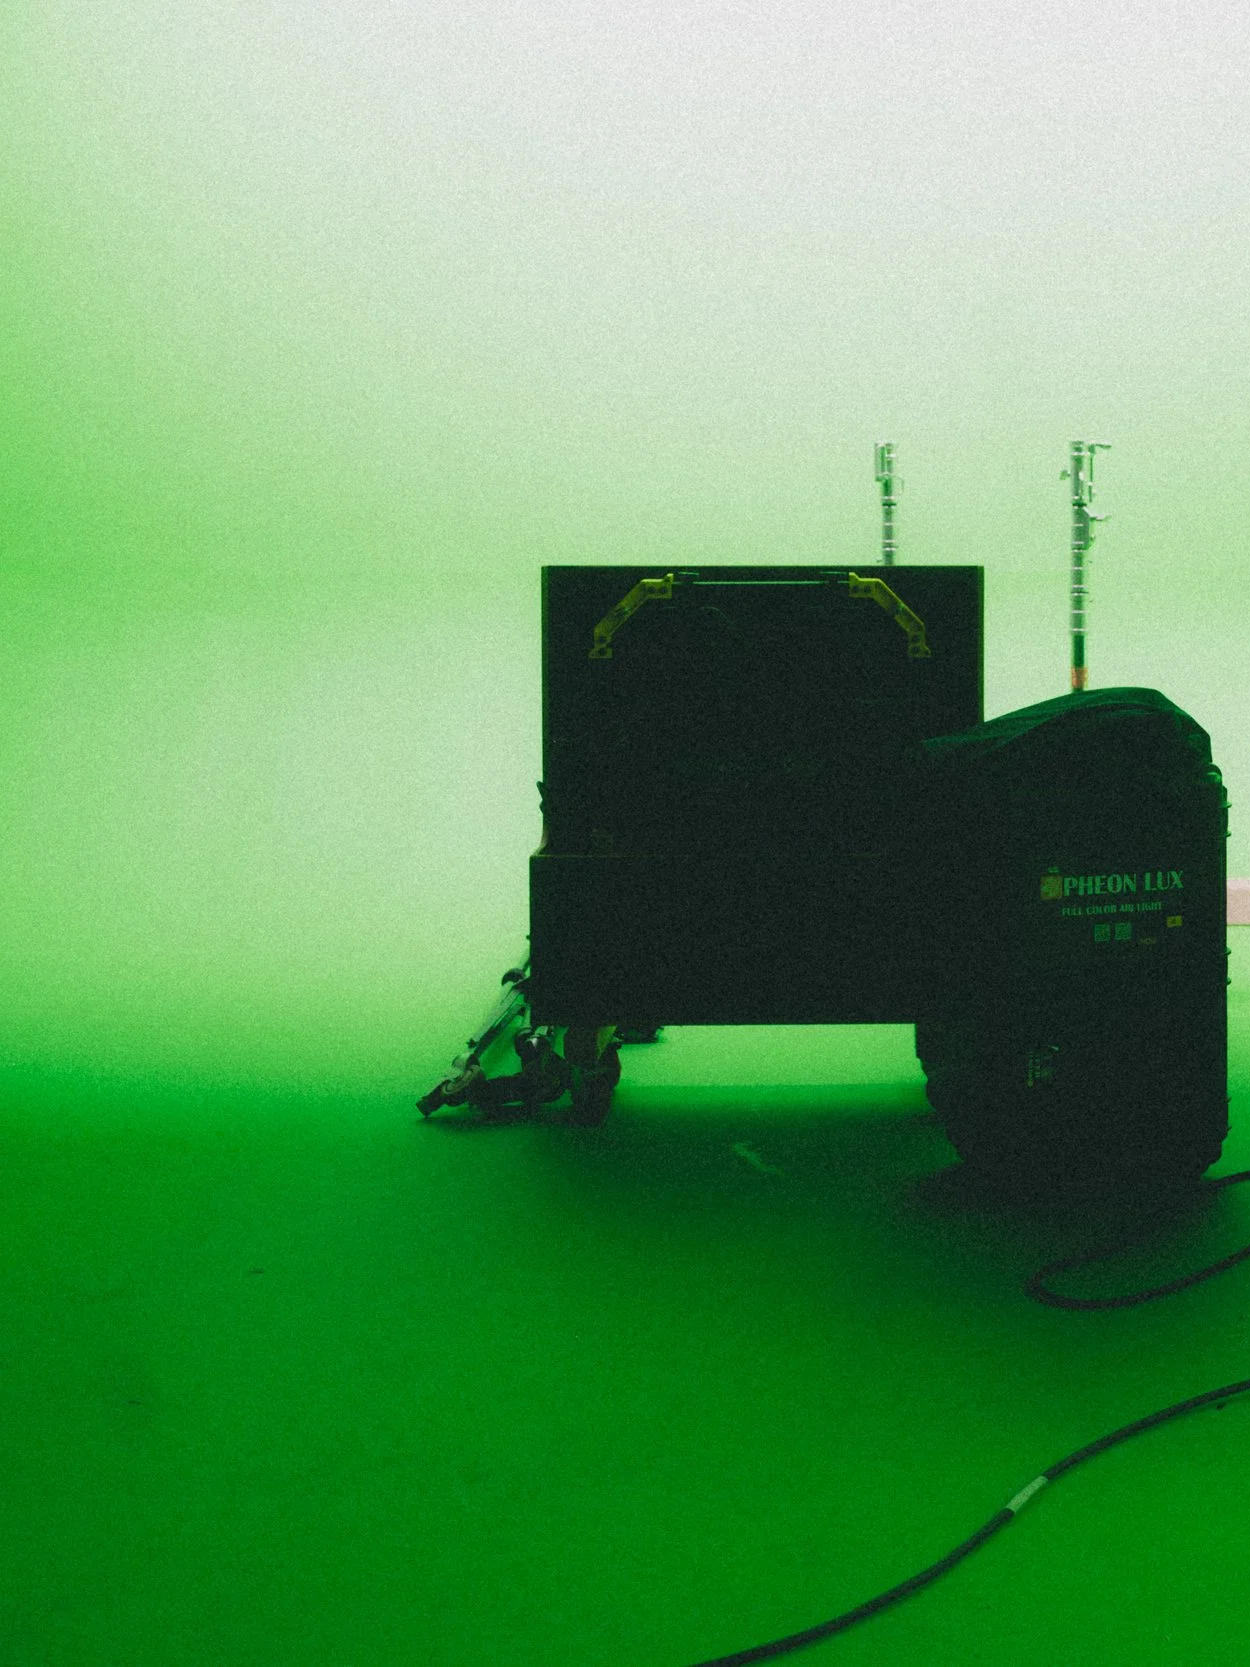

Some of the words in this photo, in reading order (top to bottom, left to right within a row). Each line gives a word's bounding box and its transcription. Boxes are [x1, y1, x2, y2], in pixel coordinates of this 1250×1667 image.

[1144, 870, 1184, 892] LUX
[1062, 907, 1082, 916] FULL
[1085, 905, 1117, 915] COLOR
